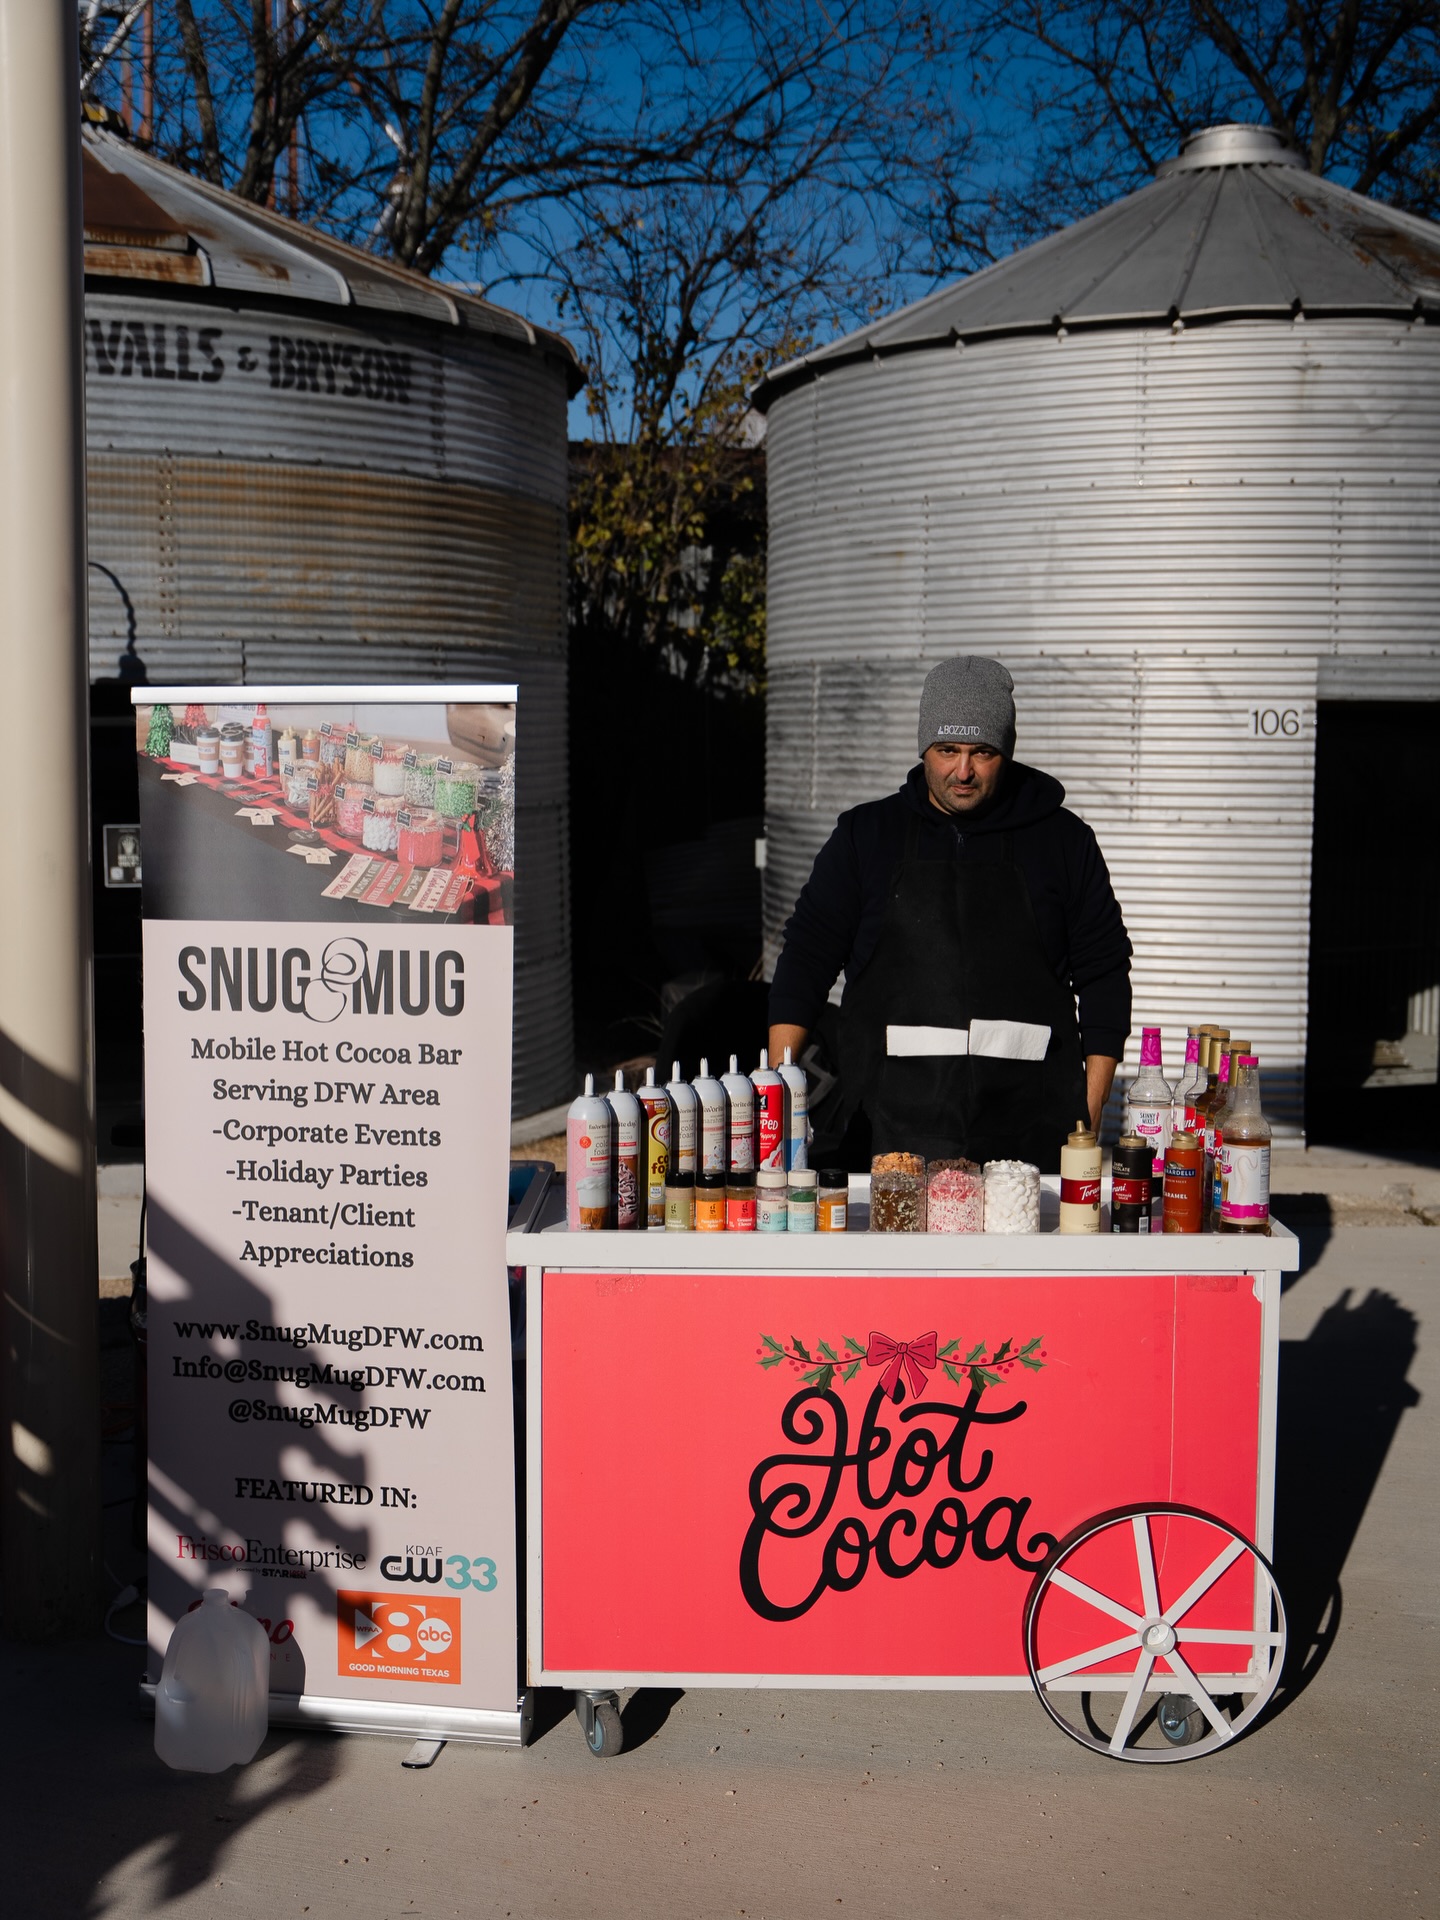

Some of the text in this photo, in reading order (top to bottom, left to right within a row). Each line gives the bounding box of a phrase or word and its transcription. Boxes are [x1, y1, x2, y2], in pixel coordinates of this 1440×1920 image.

[238, 346, 258, 372] &
[943, 725, 981, 736] BOZZUTO
[1252, 709, 1300, 735] 106
[178, 946, 465, 1017] SNUG MUG
[191, 1037, 462, 1065] Mobile Hot Cocoa Bar
[213, 1079, 440, 1108] Serving DFW Area
[213, 1120, 441, 1147] -Corporate Events
[226, 1159, 428, 1189] -Holiday Parties
[1080, 1184, 1101, 1201] Toran
[232, 1200, 416, 1229] -Tenant/Client
[240, 1240, 414, 1268] Appreciations
[173, 1319, 484, 1352] www.SnugMugDFW.com
[172, 1356, 486, 1393] Info@SnugMugDFW.com
[228, 1398, 432, 1432] @SnugMugDFW
[748, 1377, 1027, 1538] Hot
[235, 1477, 418, 1509] FEATURED IN:
[176, 1535, 367, 1572] FriscoEnterprise
[406, 1545, 442, 1557] KDAF
[739, 1482, 1060, 1622] Cocoa
[262, 1568, 289, 1578] STAR
[418, 1625, 451, 1652] abc
[349, 1663, 450, 1677] GOOD MORNING TEXAS
